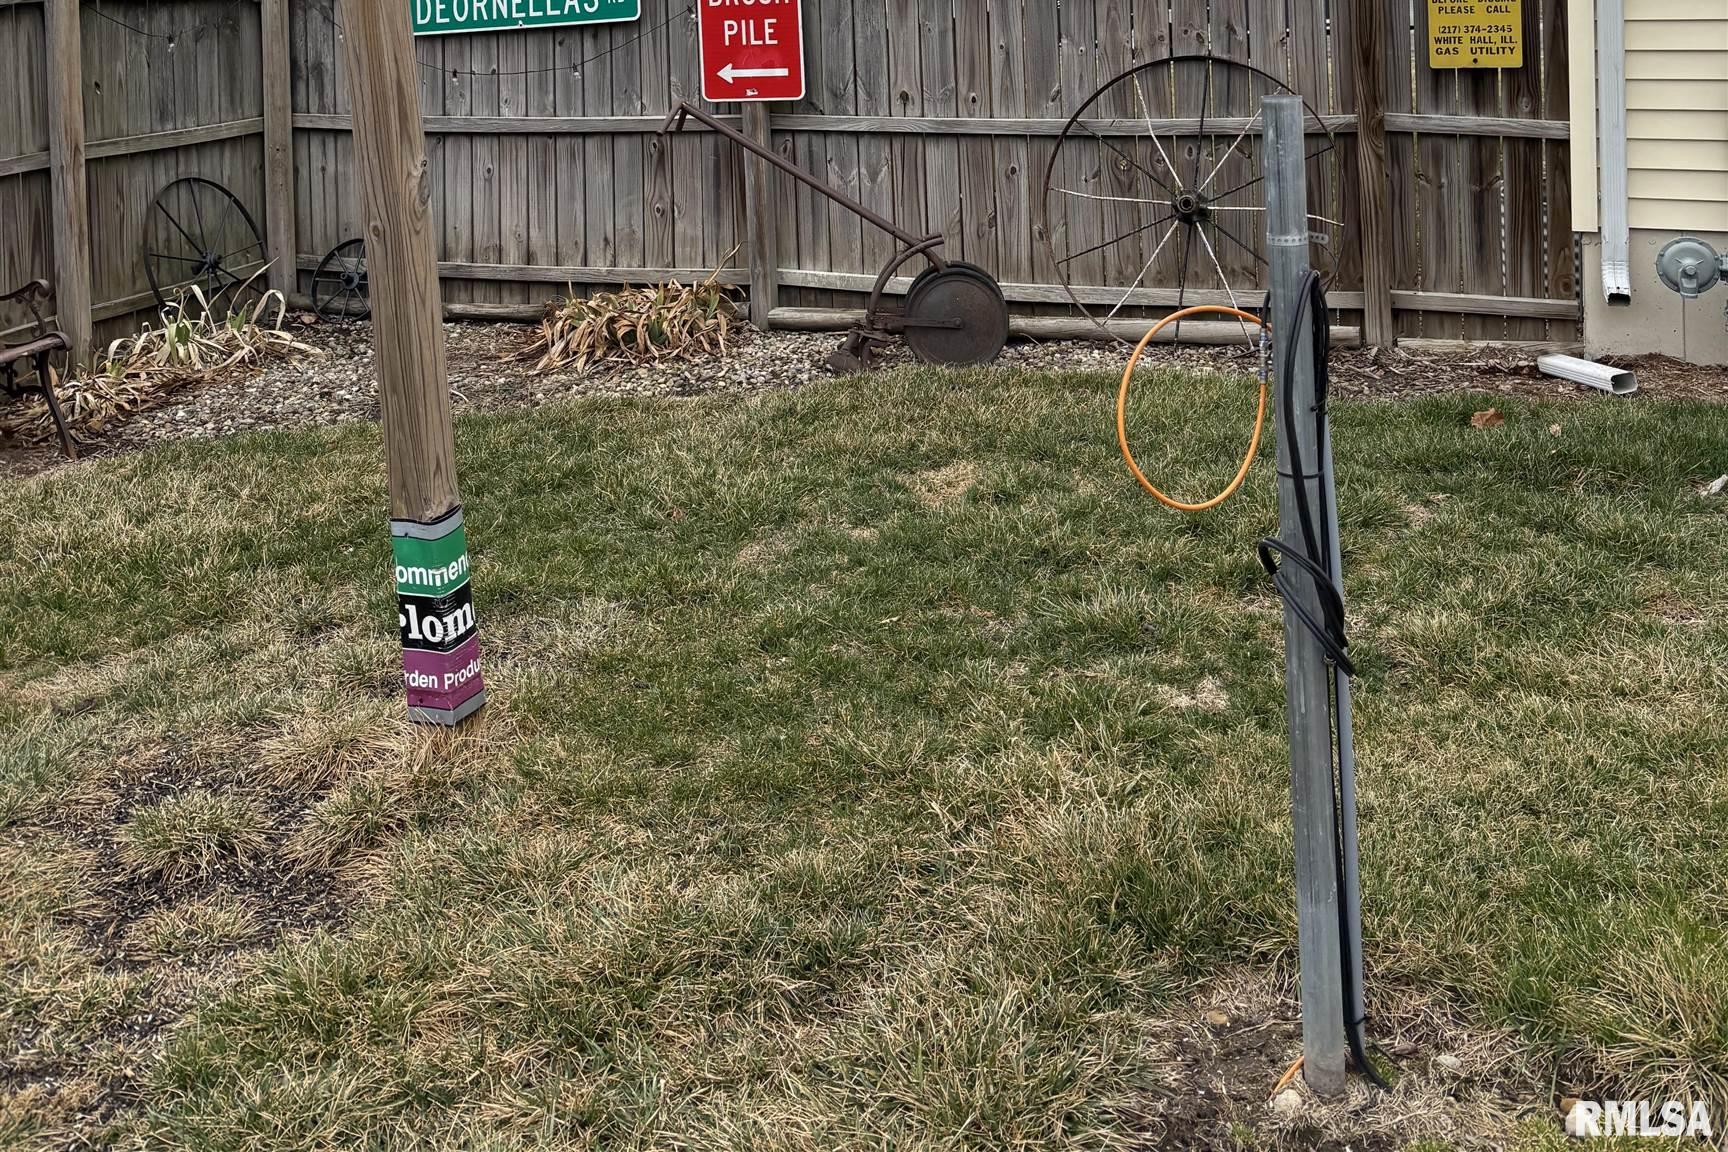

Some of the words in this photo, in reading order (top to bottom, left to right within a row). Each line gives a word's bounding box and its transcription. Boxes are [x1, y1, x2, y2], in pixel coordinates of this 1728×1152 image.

[1438, 6, 1475, 14] PLEASE
[1486, 5, 1510, 13] CALL
[723, 19, 778, 46] PILE
[1438, 25, 1460, 34] (217)
[1463, 25, 1513, 34] 374-2345
[1434, 36, 1463, 44] WHITE
[1470, 36, 1497, 45] HALL,
[1500, 36, 1518, 44] ILL.
[1435, 47, 1459, 55] GAS
[1470, 47, 1516, 55] UTILITY
